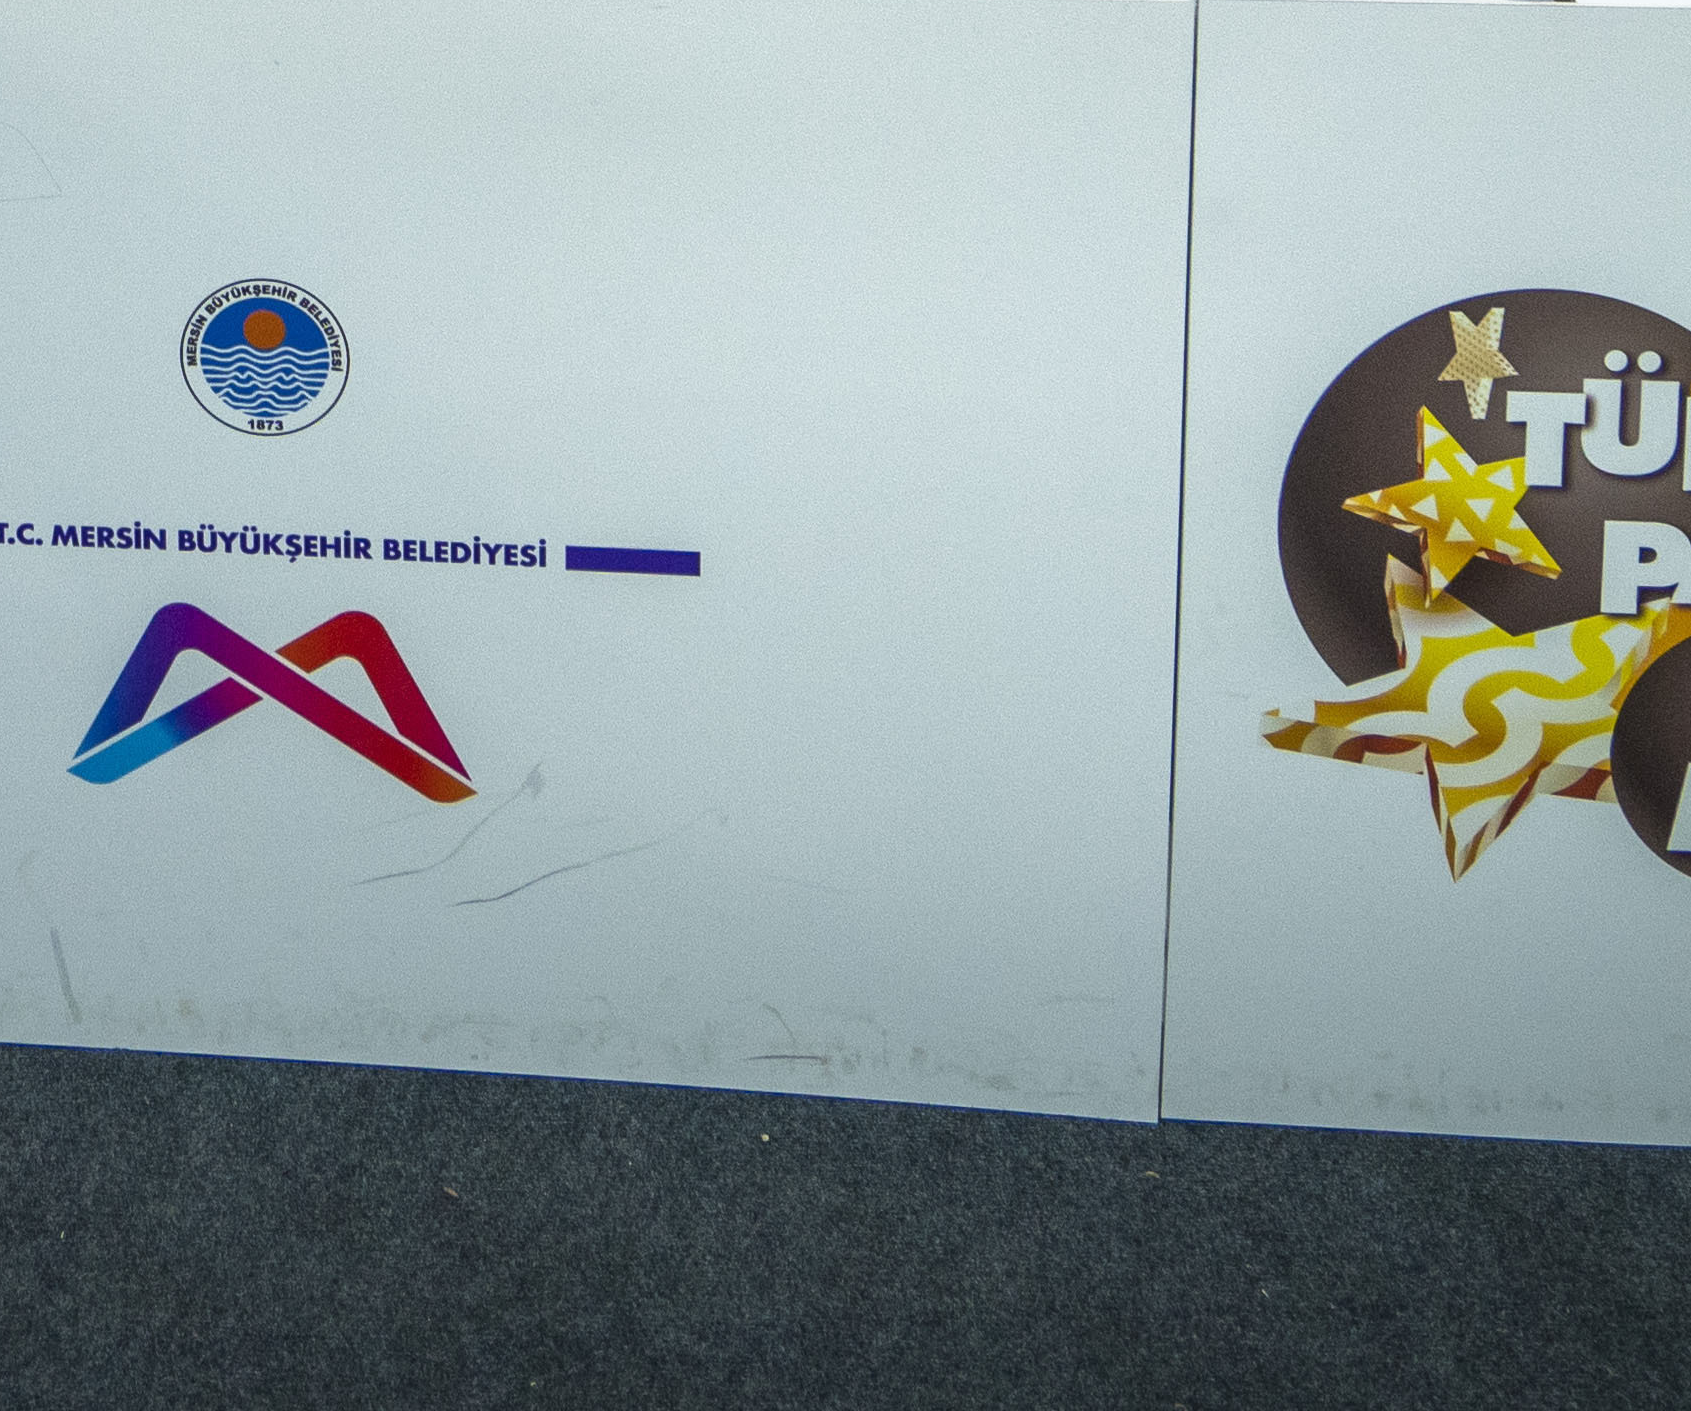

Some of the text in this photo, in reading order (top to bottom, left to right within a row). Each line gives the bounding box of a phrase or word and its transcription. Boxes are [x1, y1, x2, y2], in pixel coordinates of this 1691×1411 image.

[186, 284, 344, 372] MERSİN BÜYÜKŞEHİR BELEDİYESİ
[247, 419, 284, 430] 1873
[52, 521, 167, 552] MERSİN
[178, 525, 372, 564] BÜYÜKŞEHİR
[384, 536, 548, 569] BELEDİYESİ
